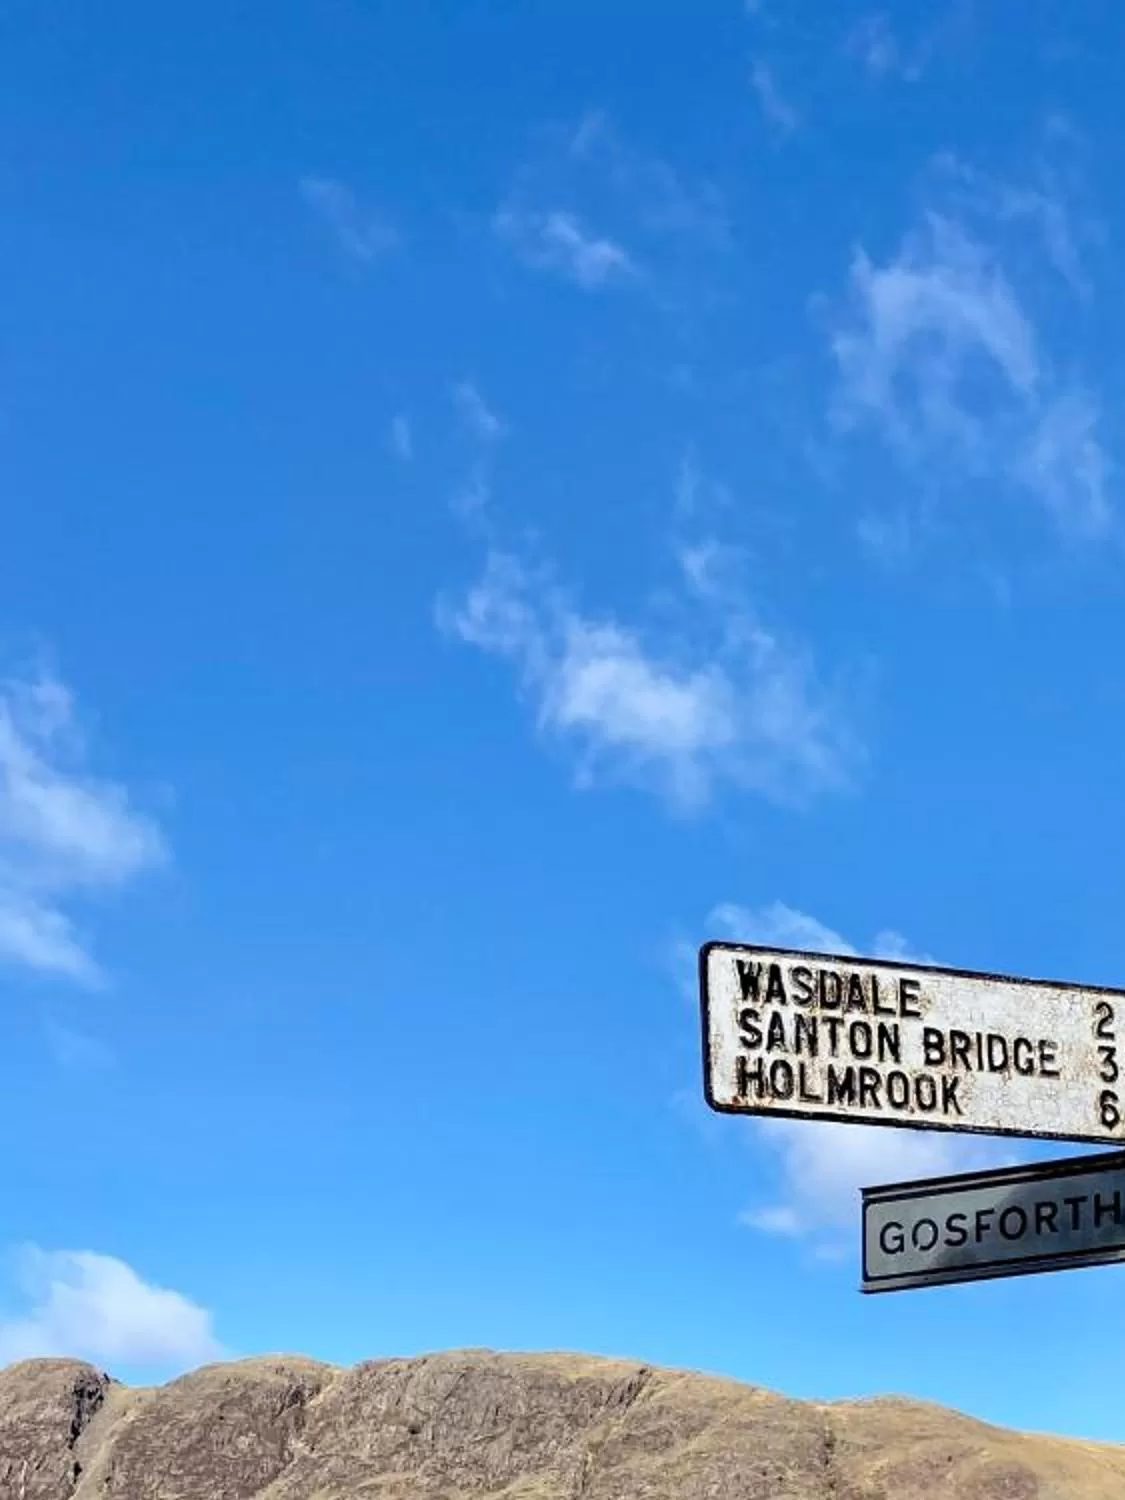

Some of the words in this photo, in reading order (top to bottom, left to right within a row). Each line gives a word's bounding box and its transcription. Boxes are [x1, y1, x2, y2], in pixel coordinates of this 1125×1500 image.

[737, 959, 921, 1017] WASDALE
[1097, 1002, 1114, 1040] 2
[739, 1008, 901, 1063] SANTON
[923, 1028, 1060, 1077] BRIDGE
[738, 1057, 963, 1116] HOLMROOK
[1100, 1090, 1120, 1130] 6
[879, 1191, 1122, 1255] GOSFORTH
